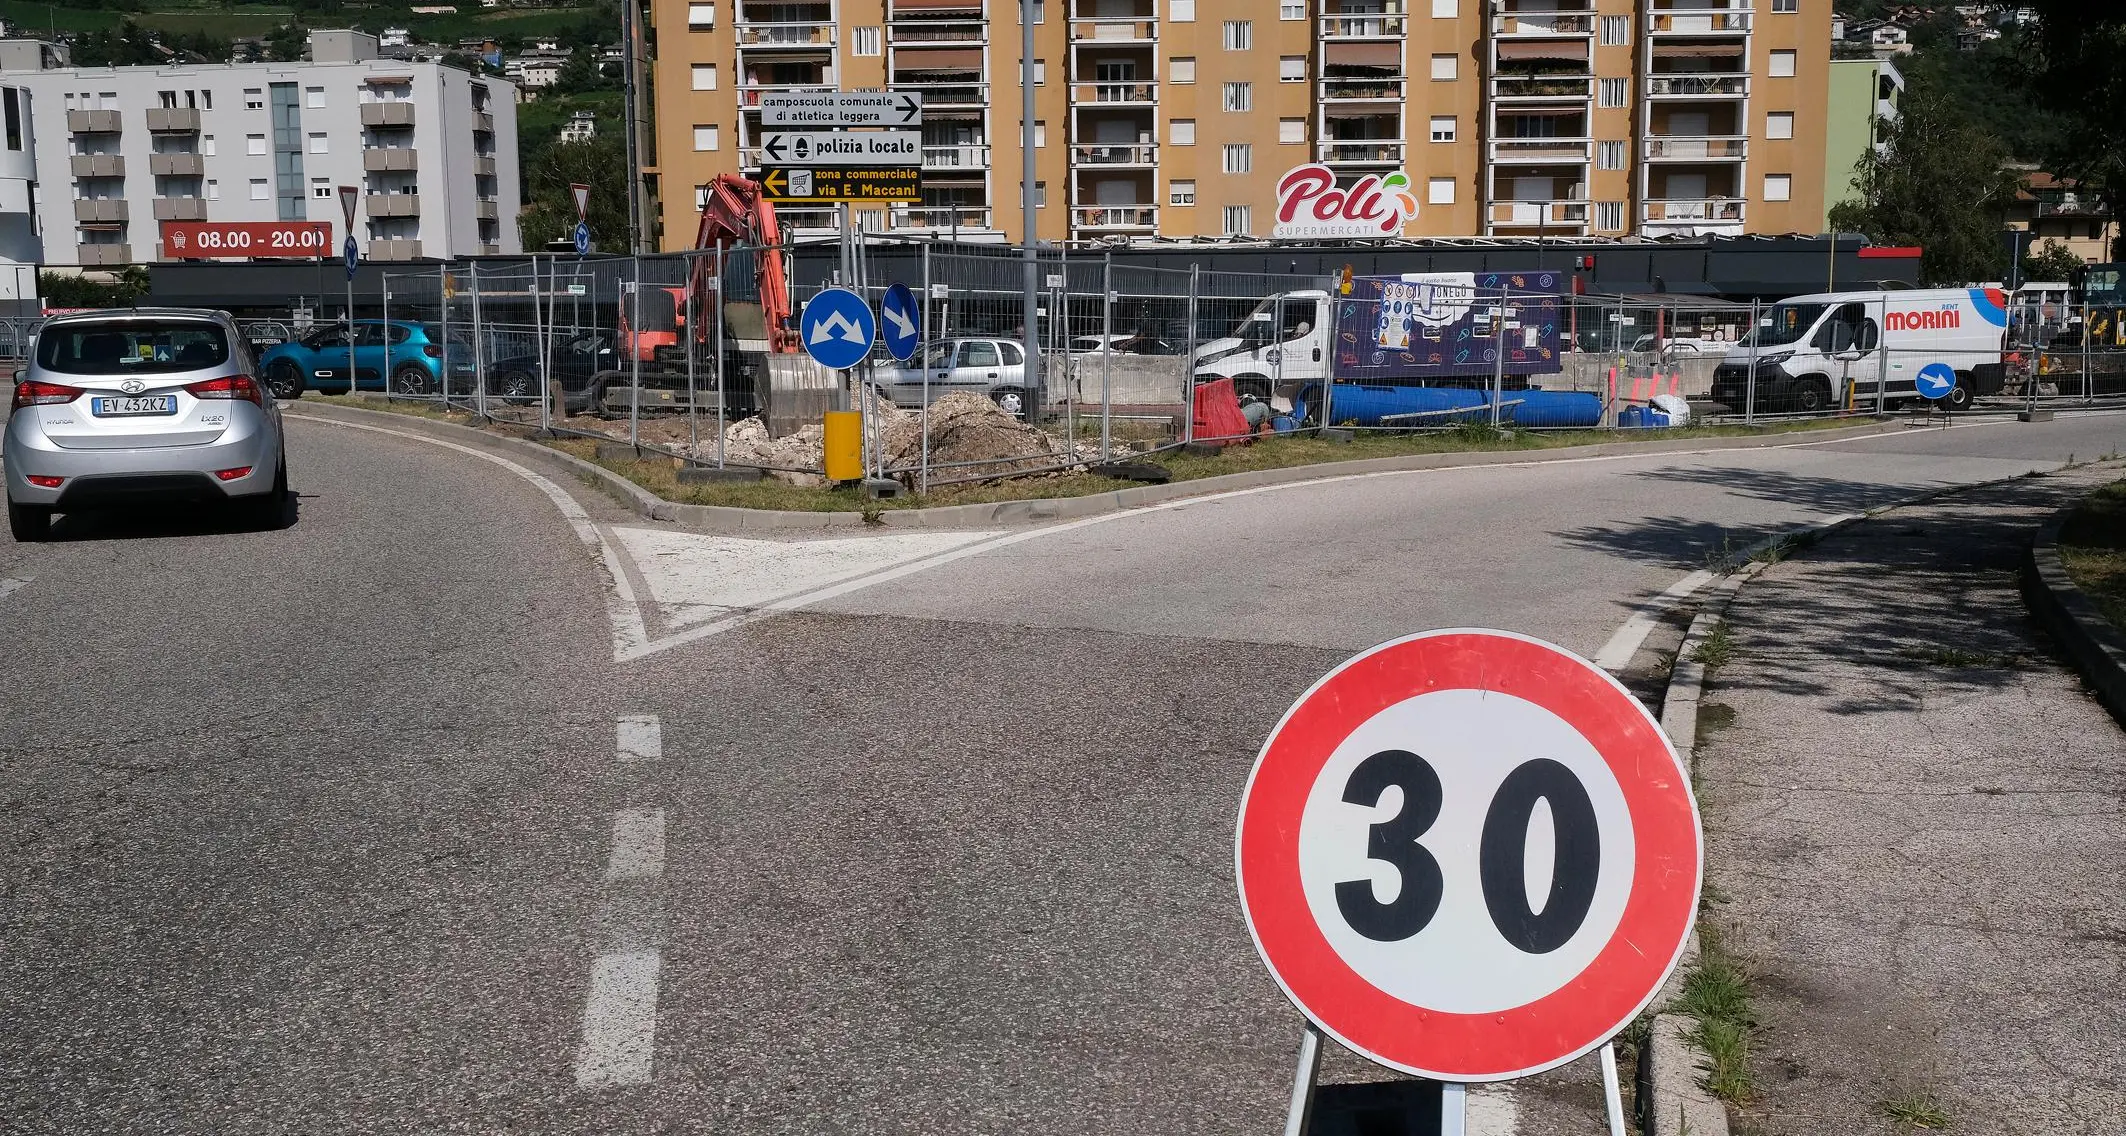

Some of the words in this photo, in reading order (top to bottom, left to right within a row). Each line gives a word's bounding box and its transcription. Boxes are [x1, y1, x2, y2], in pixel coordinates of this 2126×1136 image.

[763, 96, 835, 108] camposcuola
[839, 96, 893, 107] comunale
[776, 111, 787, 121] di
[791, 111, 834, 121] atletica
[839, 111, 880, 122] leggera
[816, 138, 863, 156] polizia
[869, 138, 914, 154] locale
[815, 170, 841, 179] zona
[846, 168, 918, 179] commerciale
[818, 184, 837, 196] via
[843, 184, 856, 196] E.
[861, 184, 916, 196] Maccani
[1279, 167, 1386, 223] Poli
[1279, 225, 1374, 236] SUPERMERCATI
[197, 231, 251, 249] 08.00
[271, 230, 325, 248] 20.00
[1885, 310, 1960, 331] MORINI
[102, 399, 119, 412] EV
[124, 397, 167, 411] 432KZ
[1334, 749, 1601, 955] 30
